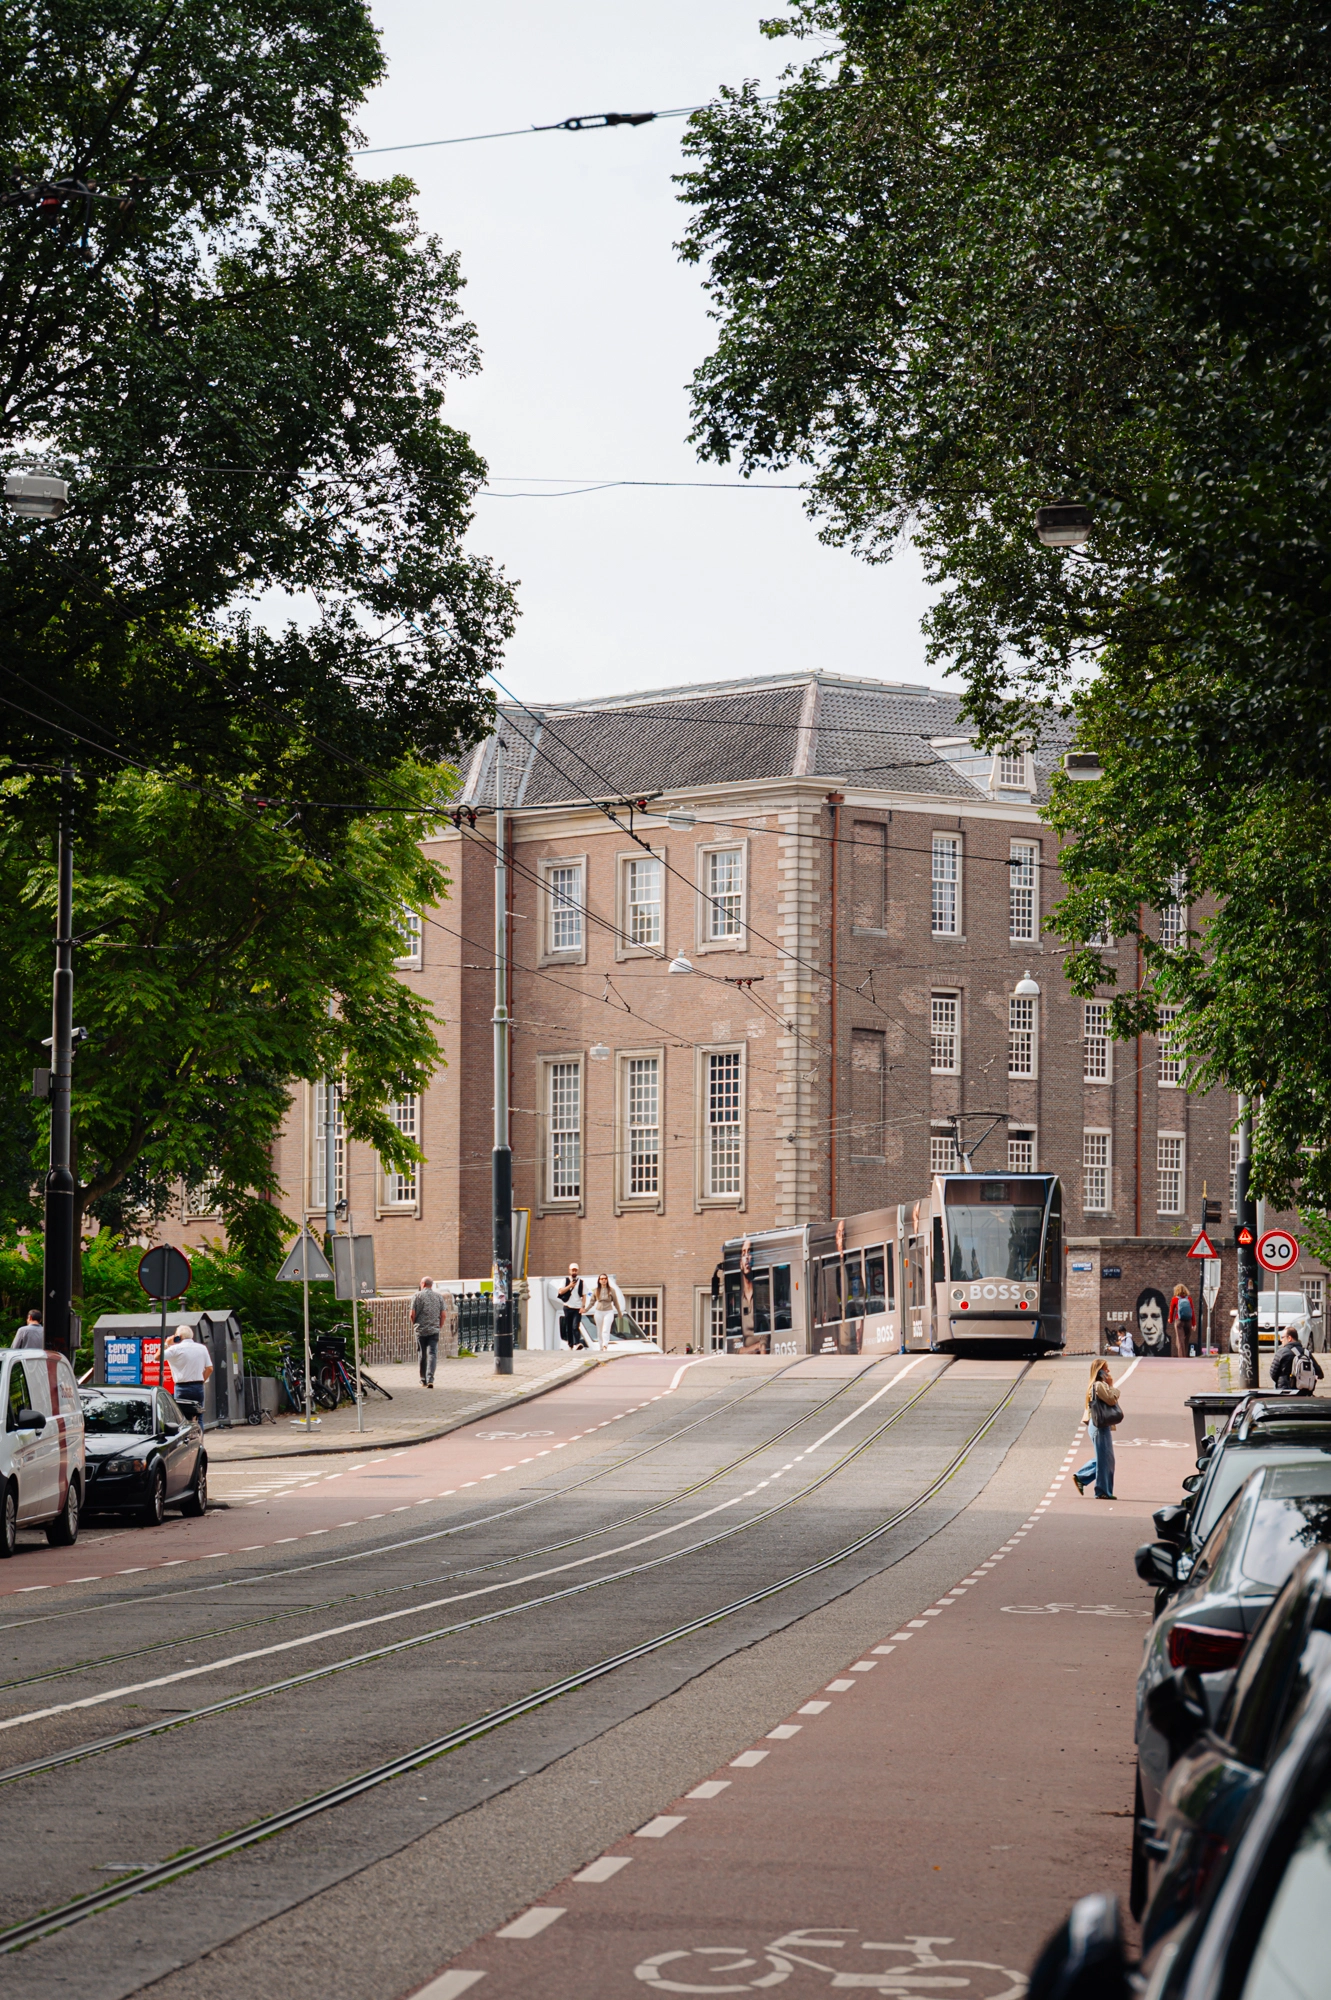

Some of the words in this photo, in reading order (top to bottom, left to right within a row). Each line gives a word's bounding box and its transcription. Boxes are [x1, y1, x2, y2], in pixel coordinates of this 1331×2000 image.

[1264, 1243, 1291, 1259] 30
[970, 1284, 1021, 1300] BOSS
[1106, 1311, 1133, 1322] LEEF!
[876, 1324, 894, 1344] BOSS
[108, 1343, 136, 1353] terras
[774, 1340, 797, 1355] BOSS
[108, 1354, 129, 1364] open!
